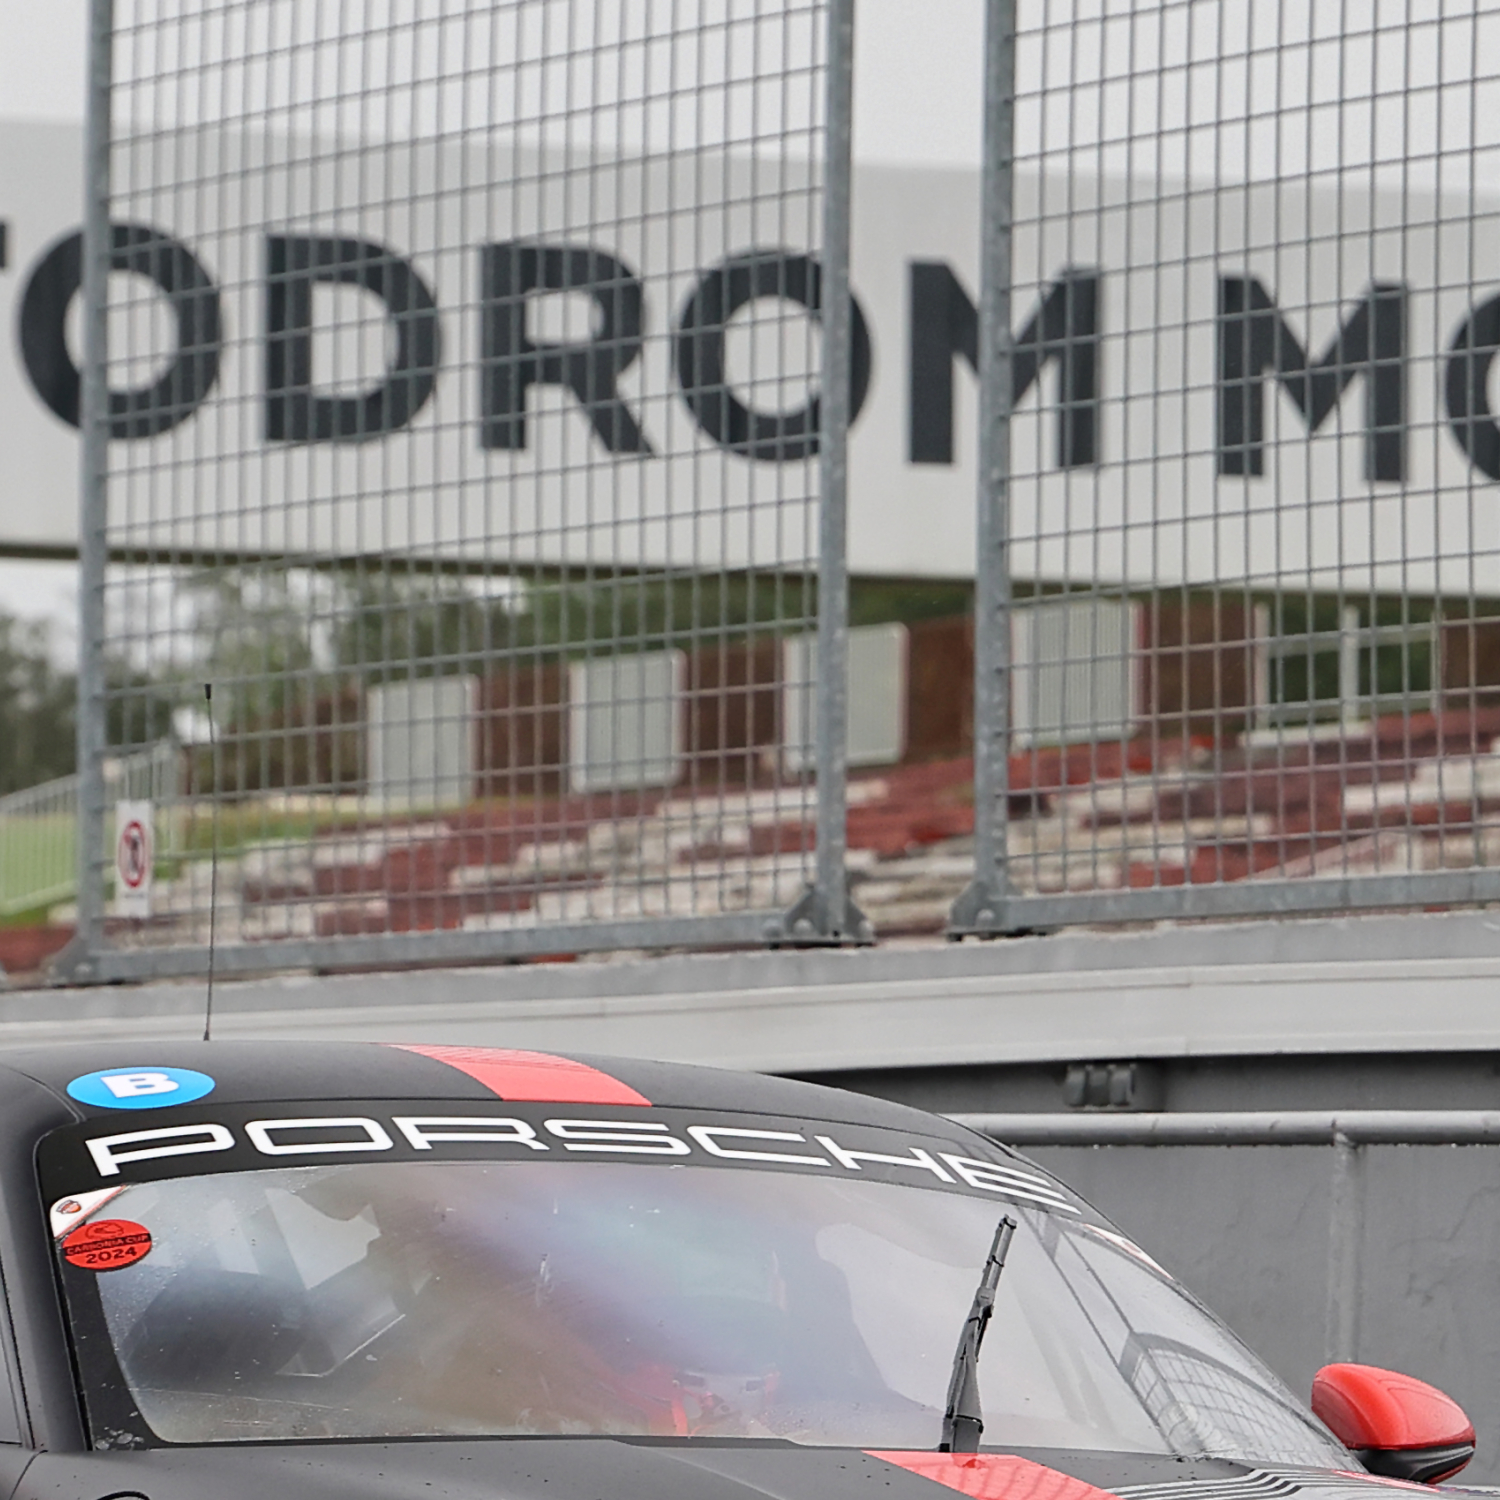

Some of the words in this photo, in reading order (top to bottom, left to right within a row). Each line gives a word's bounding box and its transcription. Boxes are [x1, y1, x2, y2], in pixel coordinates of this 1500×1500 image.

[100, 1072, 179, 1098] B
[85, 1113, 1083, 1216] PORSCHE
[85, 1246, 138, 1264] 2024
